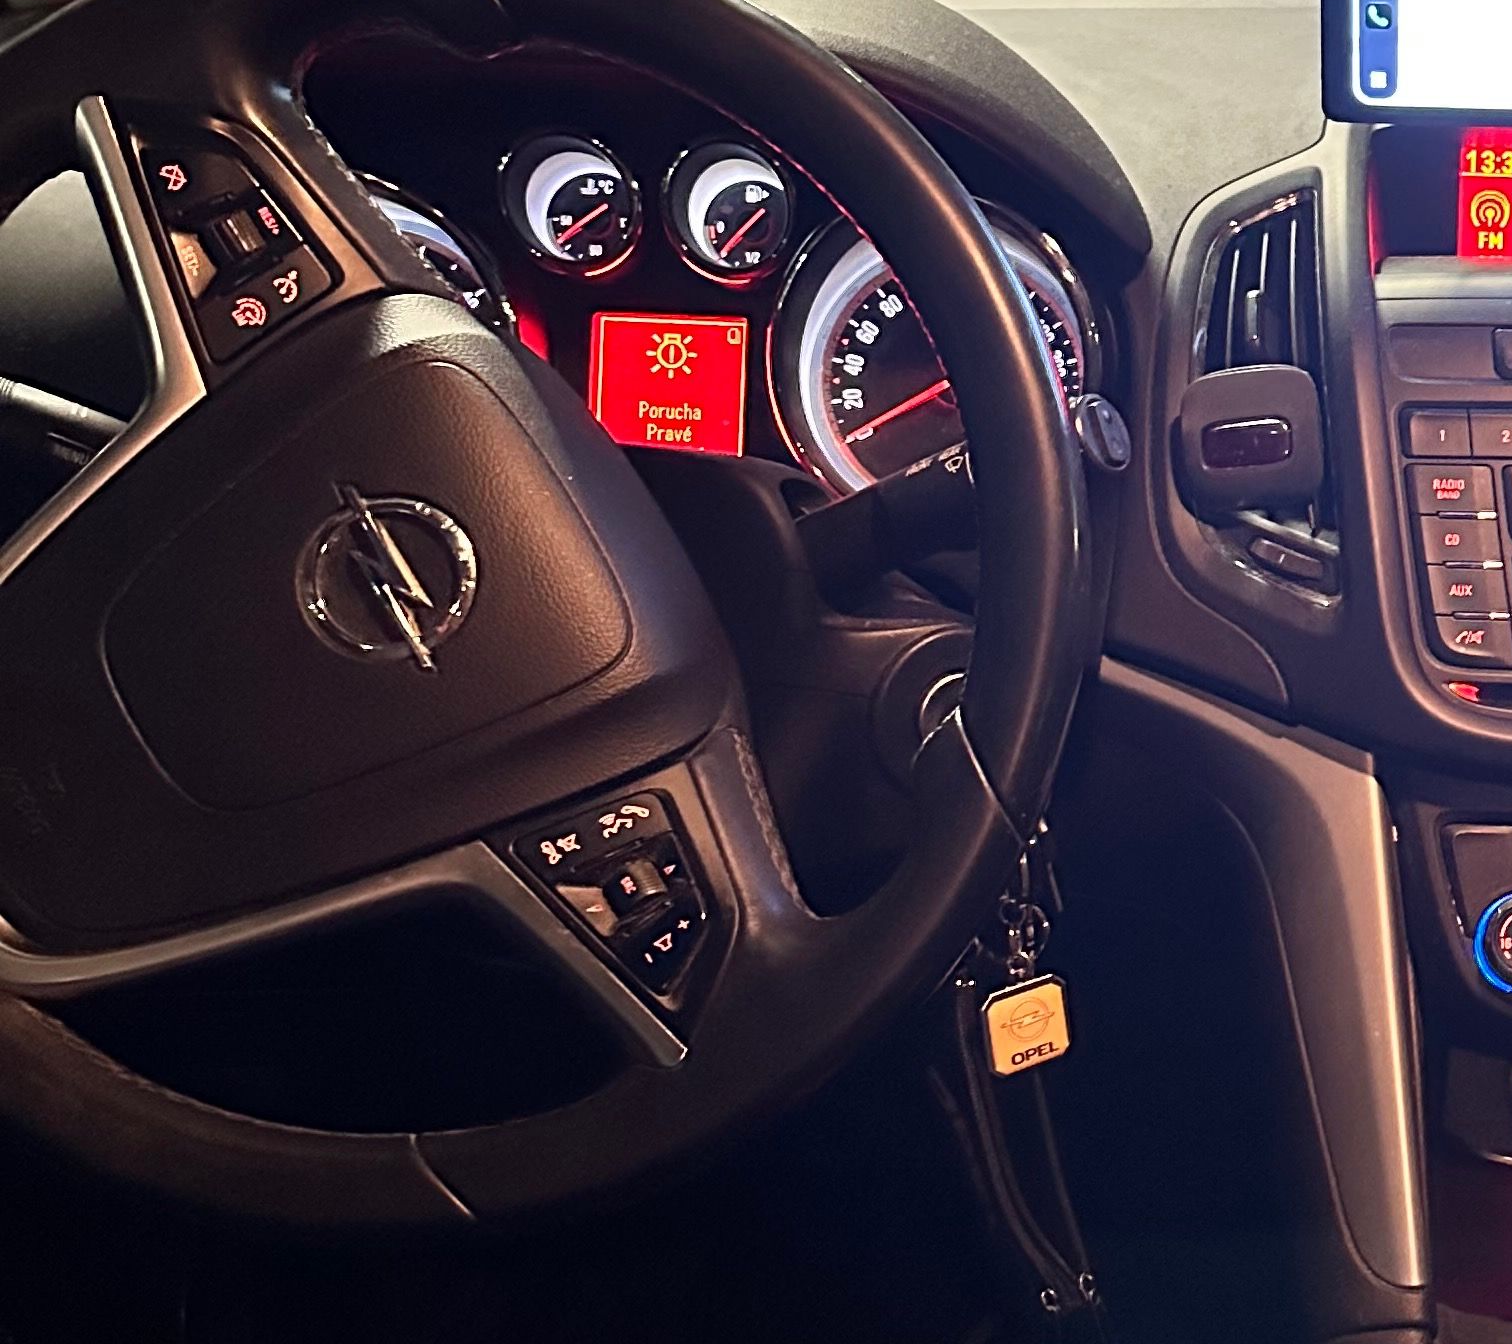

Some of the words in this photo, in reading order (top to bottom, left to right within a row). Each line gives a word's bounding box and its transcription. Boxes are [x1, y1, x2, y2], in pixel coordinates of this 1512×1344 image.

[1478, 231, 1504, 249] FM
[879, 294, 904, 318] 80
[855, 320, 880, 344] 60
[843, 353, 865, 376] 40
[842, 388, 864, 410] 20
[638, 400, 702, 421] Porucha
[646, 423, 692, 443] Pravé
[1439, 430, 1446, 441] 1
[1501, 430, 1511, 443] 2
[1432, 478, 1465, 490] RADIO
[1444, 533, 1460, 546] CD
[1449, 584, 1473, 596] AUX
[1011, 1042, 1059, 1065] OPEL
